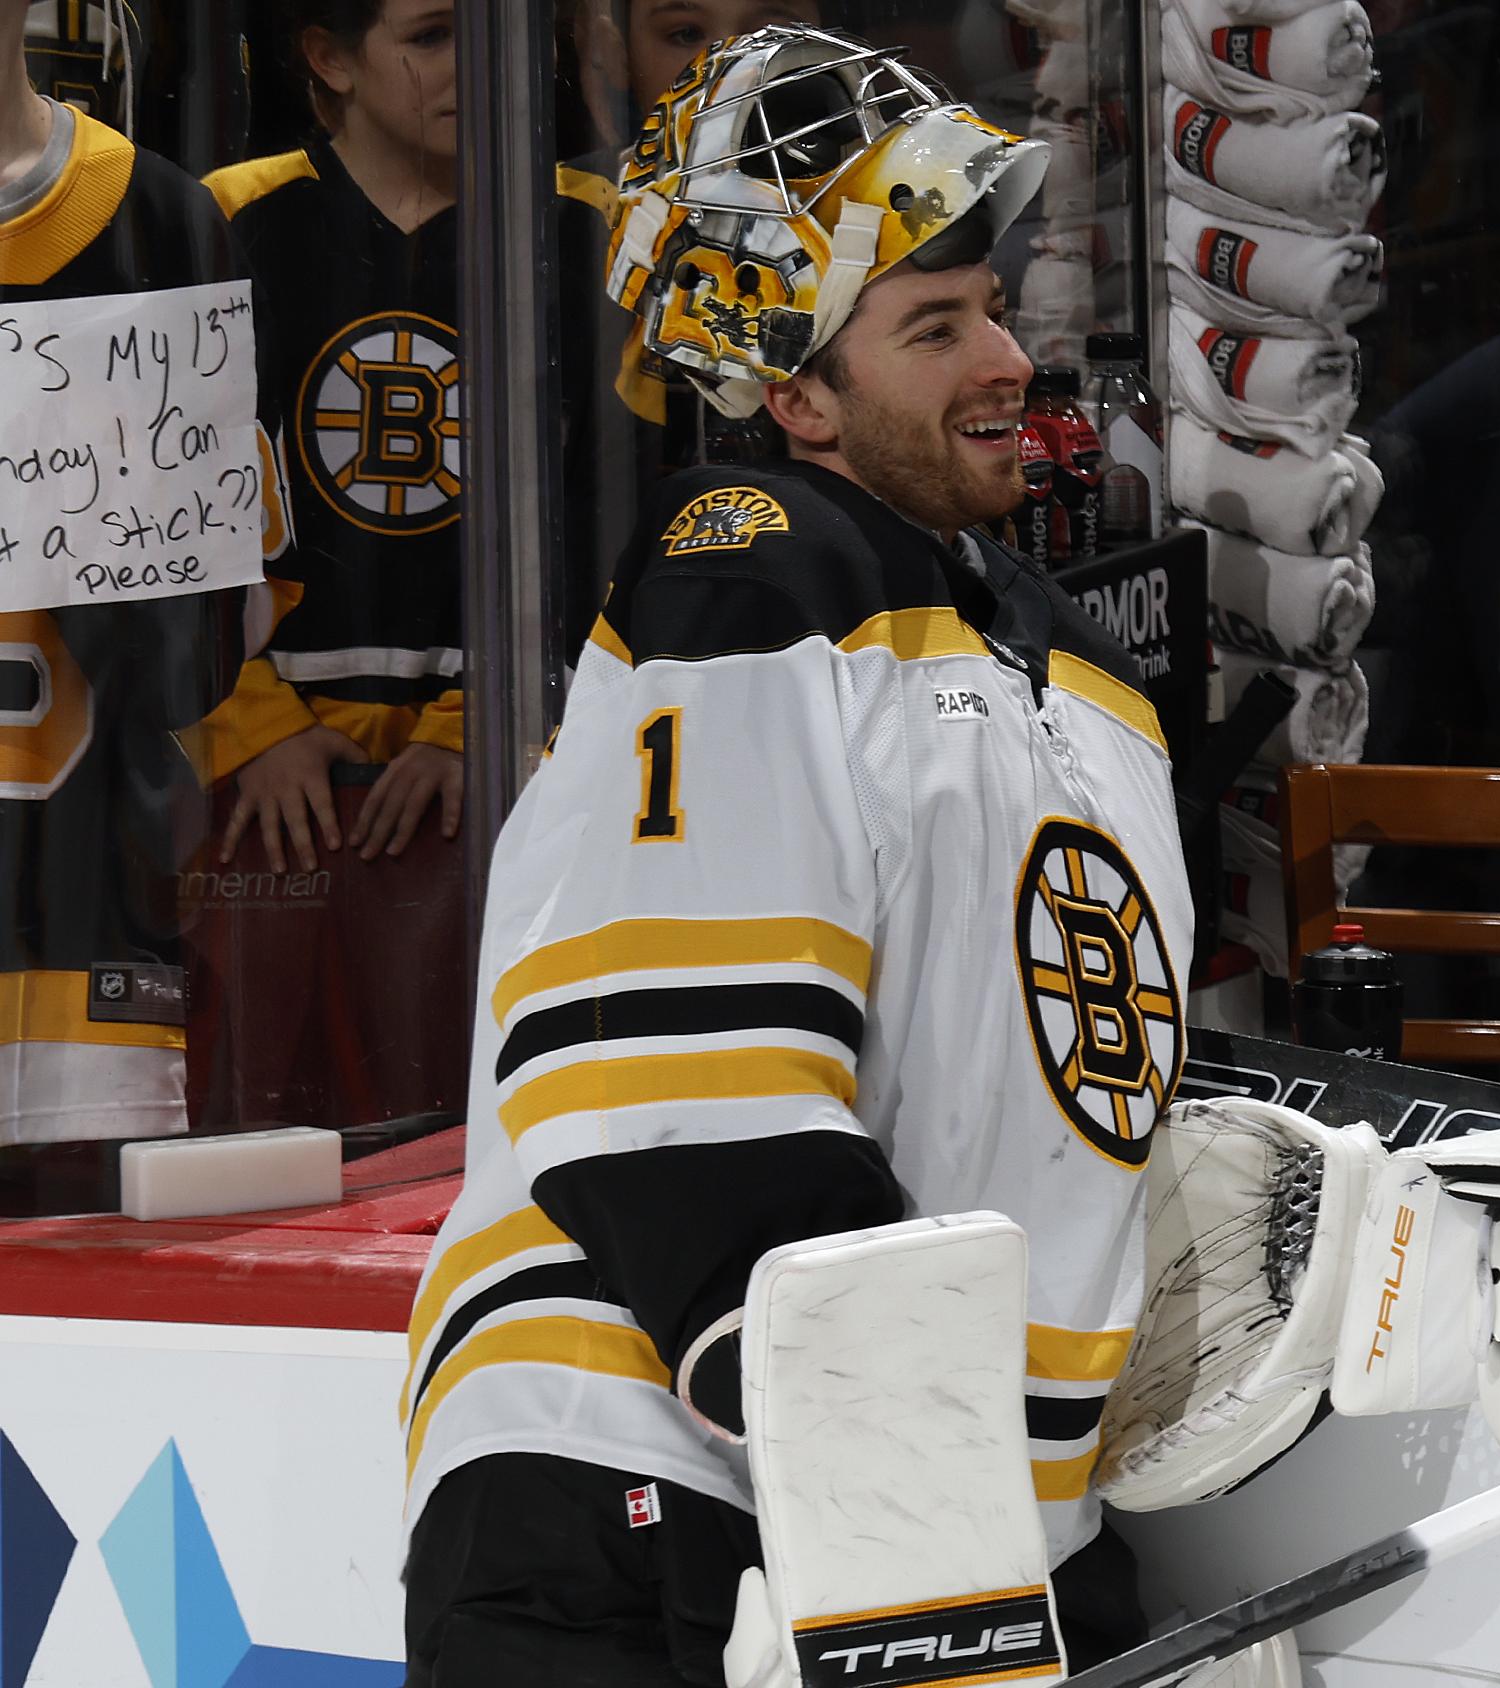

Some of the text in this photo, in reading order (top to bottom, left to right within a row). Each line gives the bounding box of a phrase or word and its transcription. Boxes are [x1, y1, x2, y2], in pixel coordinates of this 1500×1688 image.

[106, 325, 171, 430] My
[354, 361, 447, 488] B
[152, 405, 220, 470] Can
[42, 525, 77, 559] a
[665, 489, 785, 537] BOSTON
[630, 705, 684, 844] 1
[1050, 891, 1154, 1098] B
[1366, 1204, 1417, 1375] TRUE
[818, 1621, 1045, 1675] TRUE
